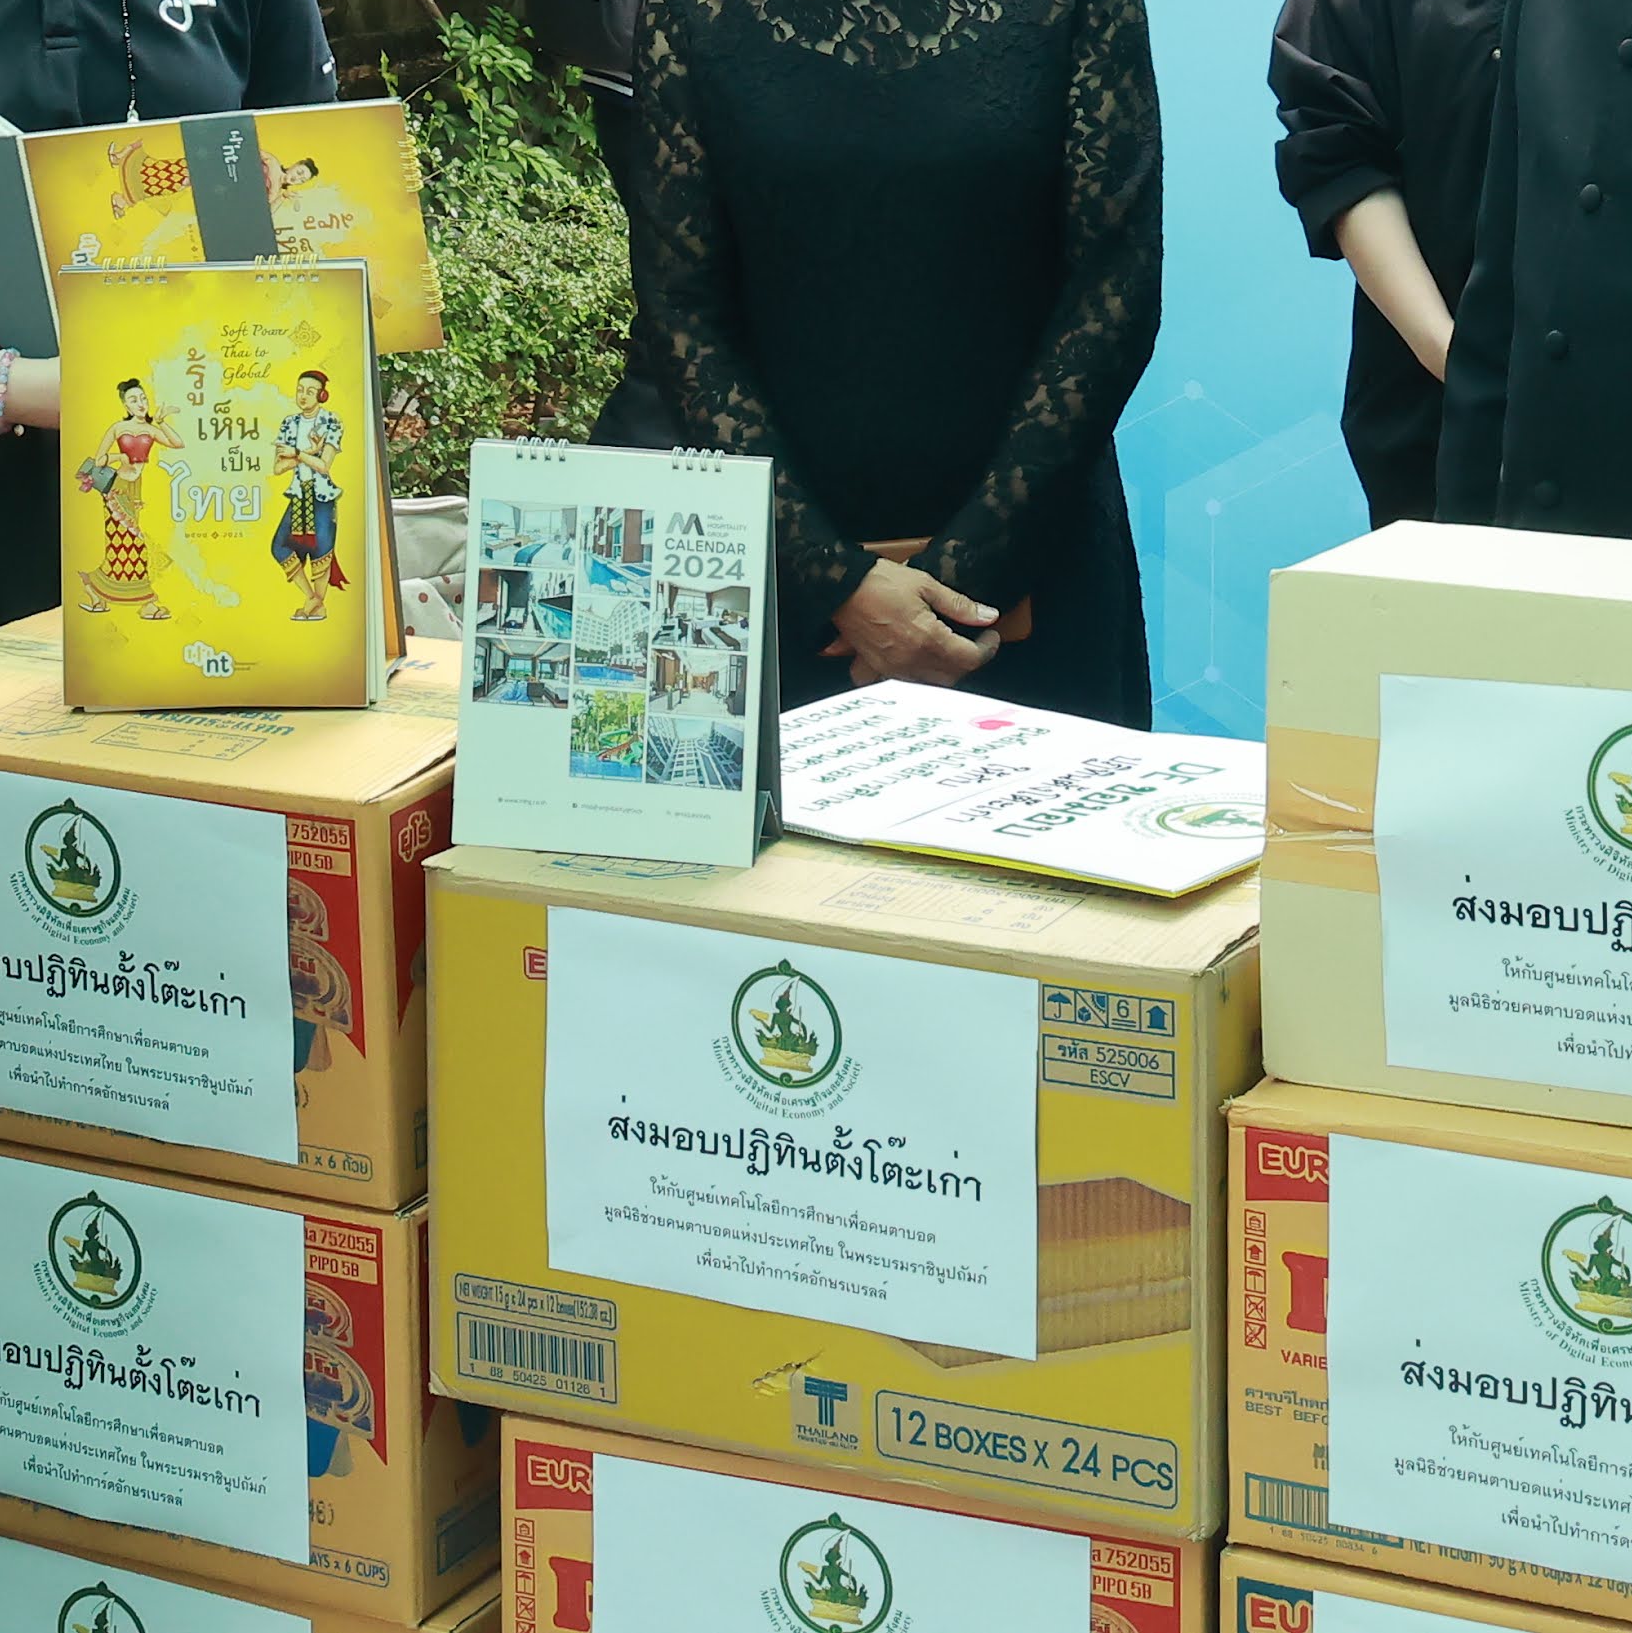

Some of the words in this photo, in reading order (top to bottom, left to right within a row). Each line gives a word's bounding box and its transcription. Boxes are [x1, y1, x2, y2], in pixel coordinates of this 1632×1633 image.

[221, 322, 249, 342] Soft
[252, 325, 289, 337] Power
[221, 341, 251, 358] Thai
[255, 346, 269, 357] to
[186, 347, 205, 406] รู้
[223, 363, 271, 385] Global
[198, 400, 260, 441] เห็น
[221, 445, 261, 472] เป็น
[159, 460, 261, 522] ไทย
[665, 538, 745, 555] CALENDAR
[664, 554, 745, 581] 2024
[290, 823, 348, 846] 752055
[1564, 809, 1591, 855] Ministry
[1593, 856, 1607, 866] of
[1058, 1040, 1088, 1060] รหัส
[1096, 1047, 1159, 1070] 525006
[8, 1066, 170, 1112] เพื่อนำไปทำการ์ดอักษรเบรลล์
[126, 1056, 254, 1097] ในพระบรมราชินูปถัมภ์
[712, 1038, 734, 1082] Ministry
[735, 1084, 746, 1094] of
[746, 1093, 777, 1117] Digital
[782, 1107, 825, 1119] Economy
[829, 1096, 843, 1110] and
[842, 1061, 863, 1094] Society
[1090, 1069, 1130, 1088] ESCV
[328, 1154, 338, 1169] 6
[608, 1095, 982, 1202] ส่งมอบปฏิทินตั้งโต๊ะเก่า
[650, 1174, 936, 1245] ให้กับศูนย์เทคโนโลยีการศึกษาเพื่อคนตาบอด
[320, 1229, 375, 1255] 752055
[604, 1203, 834, 1258] มูลนิธิช่วยคนตาบอดแห่งประเทศไทย
[838, 1241, 988, 1286] ในพระบรมราชินูปถัมภ์
[310, 1254, 339, 1276] PIPO
[342, 1257, 360, 1277] 5B
[696, 1248, 888, 1301] เพื่อนำไปทำการ์ดอักษรเบรลล์
[495, 1285, 503, 1303] 15
[546, 1294, 555, 1313] 12
[1519, 1281, 1544, 1328] Ministry
[1546, 1329, 1559, 1340] of
[1559, 1339, 1596, 1364] Digital
[490, 1366, 503, 1379] 88
[513, 1370, 547, 1386] 50425
[1245, 1402, 1282, 1417] BEST
[796, 1423, 859, 1444] THAILAND
[892, 1406, 927, 1448] 12
[935, 1422, 1027, 1464] BOXES
[1033, 1440, 1049, 1469] X
[1062, 1436, 1101, 1479] 24
[1112, 1454, 1174, 1492] PCS
[22, 1454, 184, 1509] เพื่อนำไปทำการ์ดอักษรเบรลล์
[140, 1450, 267, 1498] ในพระบรมราชินูปถัมภ์
[526, 1453, 594, 1495] EUR
[344, 1558, 353, 1575] 6
[356, 1561, 388, 1583] CUPS
[1103, 1549, 1172, 1575] 752055
[1092, 1574, 1128, 1597] PIPO
[1131, 1578, 1152, 1600] 5B
